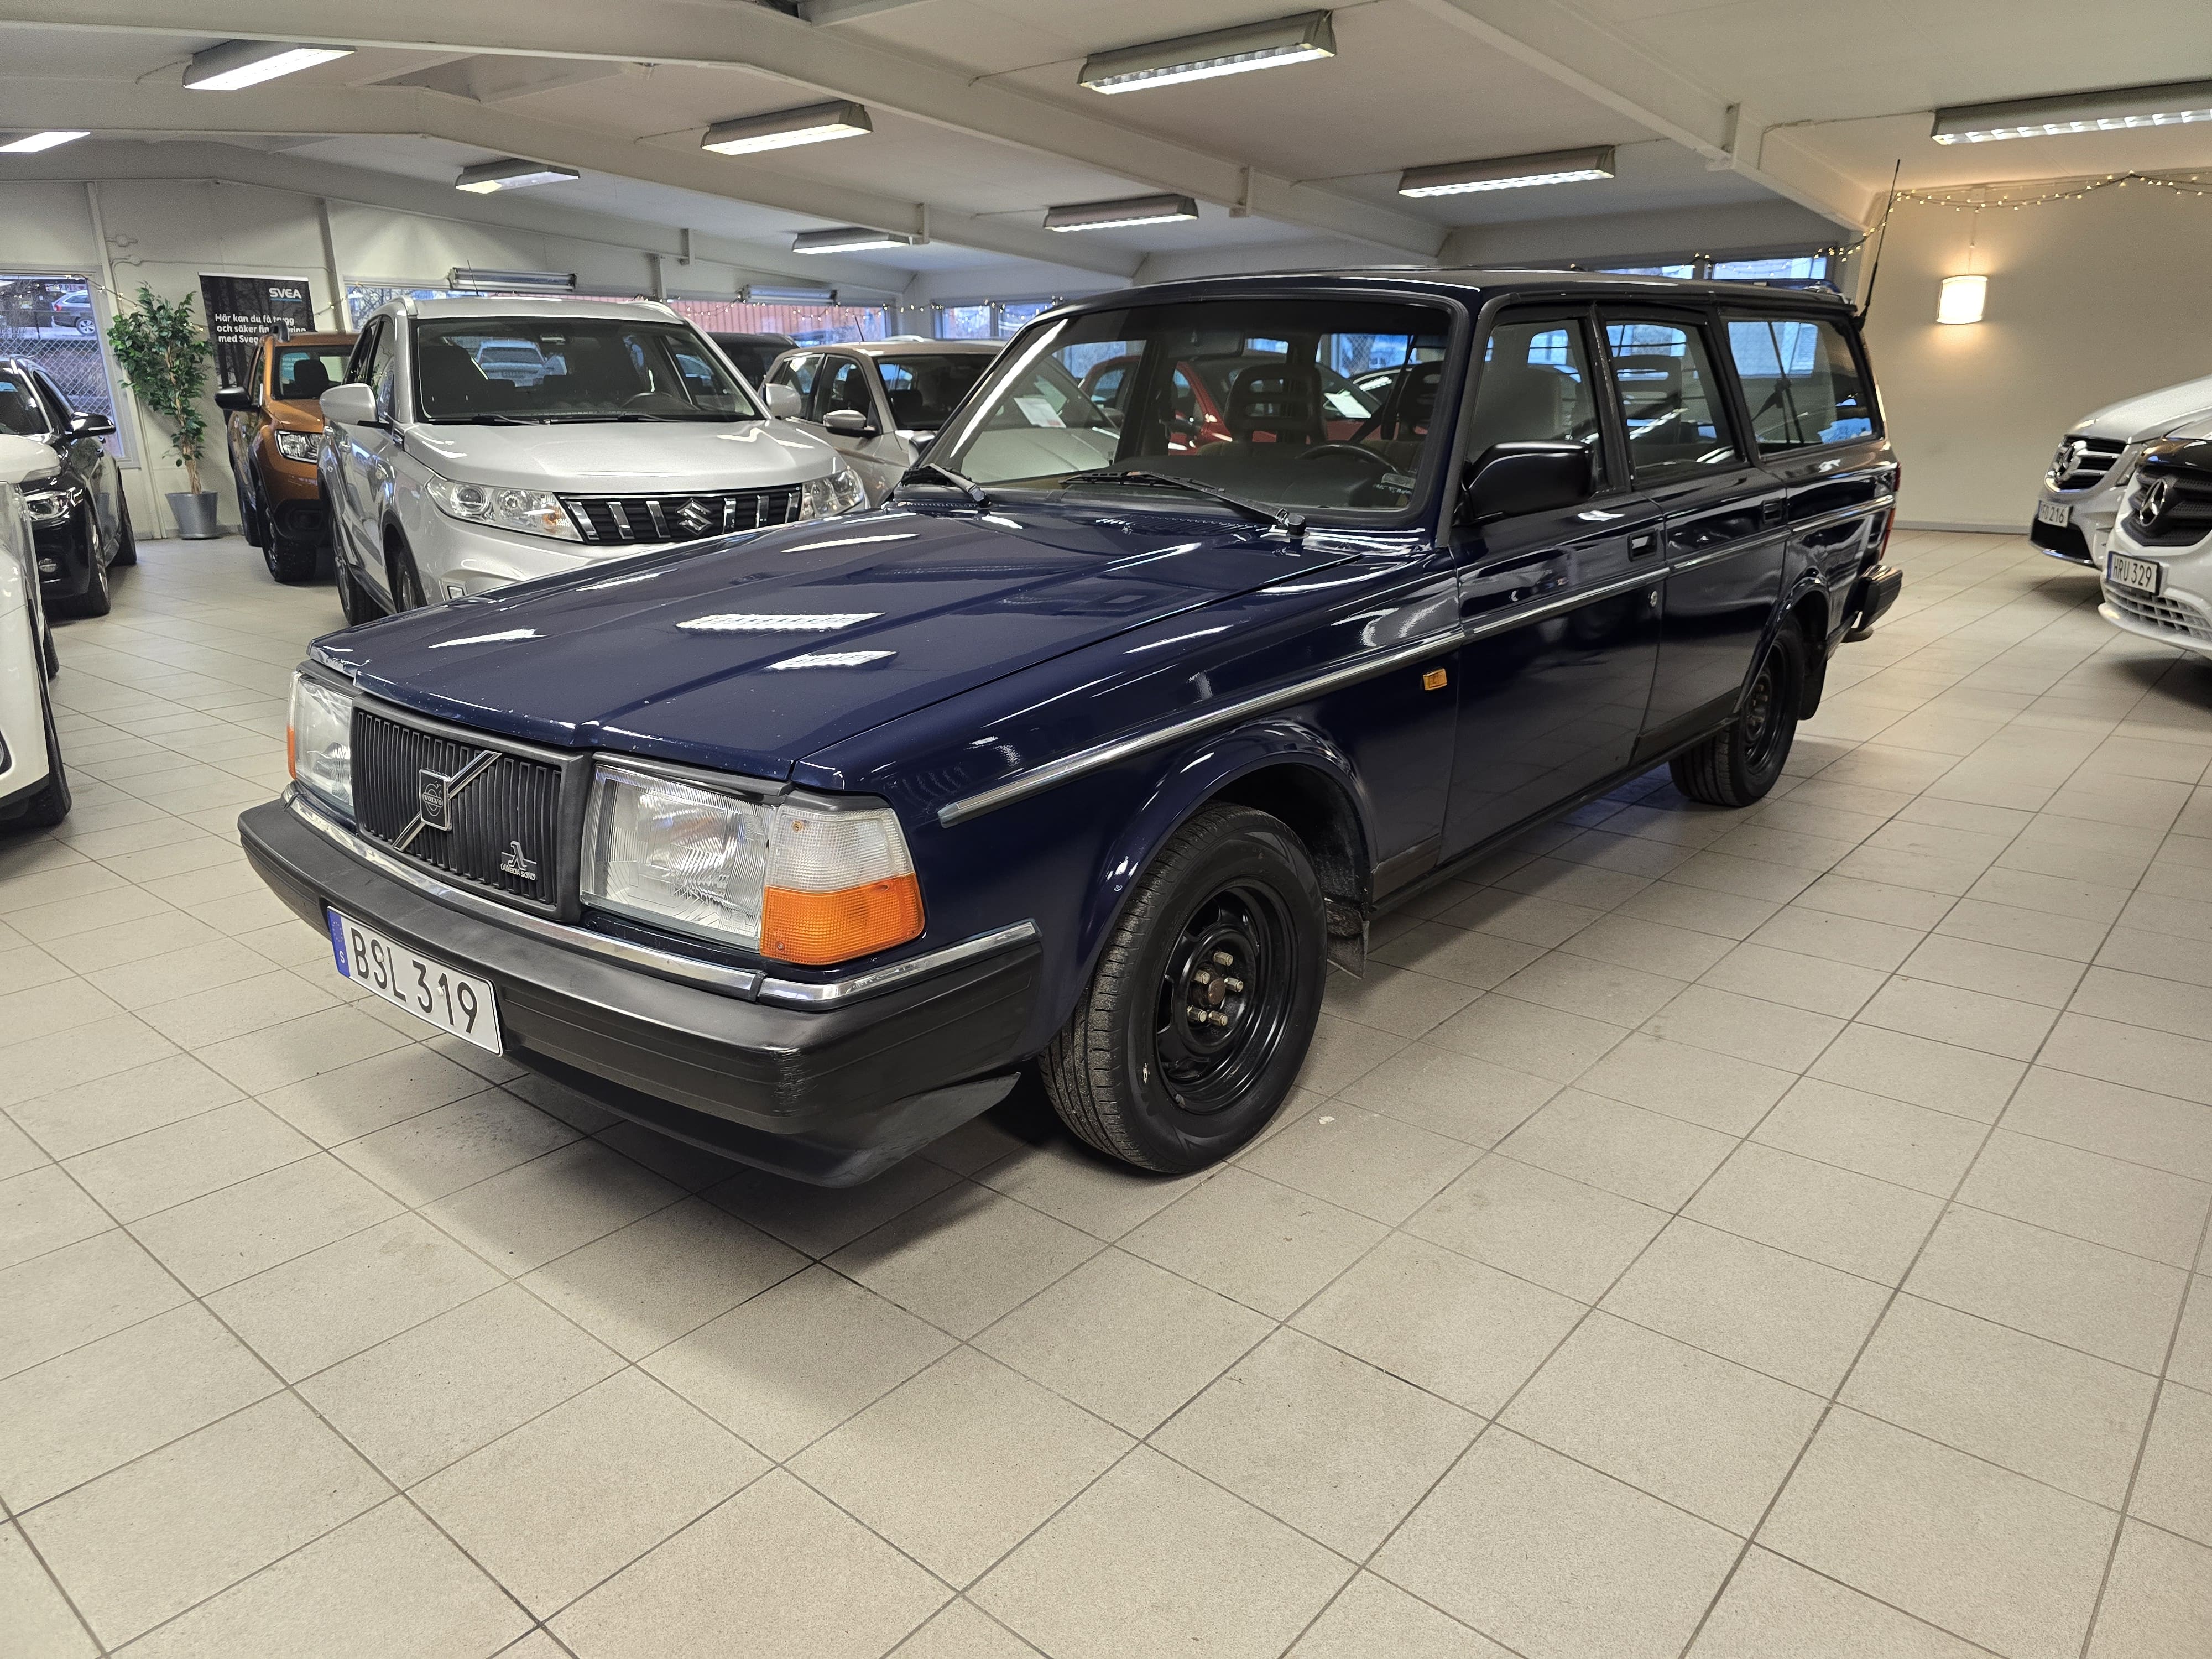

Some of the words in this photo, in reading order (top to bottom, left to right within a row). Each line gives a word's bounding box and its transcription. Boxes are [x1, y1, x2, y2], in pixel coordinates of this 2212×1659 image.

[269, 288, 302, 299] SVEA
[215, 314, 231, 322] Här
[233, 314, 248, 323] kan
[250, 314, 261, 323] du
[263, 315, 272, 324] få
[273, 316, 294, 326] trgg
[217, 324, 232, 332] och
[234, 324, 257, 333] säker
[218, 333, 237, 343] med
[2049, 506, 2065, 524] 216
[2114, 557, 2130, 581] HRU
[2131, 563, 2152, 587] 329
[424, 794, 442, 806] VOLVO
[500, 863, 520, 876] LAMBDA
[521, 871, 536, 880] SOND
[339, 950, 345, 963] S
[351, 927, 406, 1002] BSL
[412, 959, 478, 1034] 319
